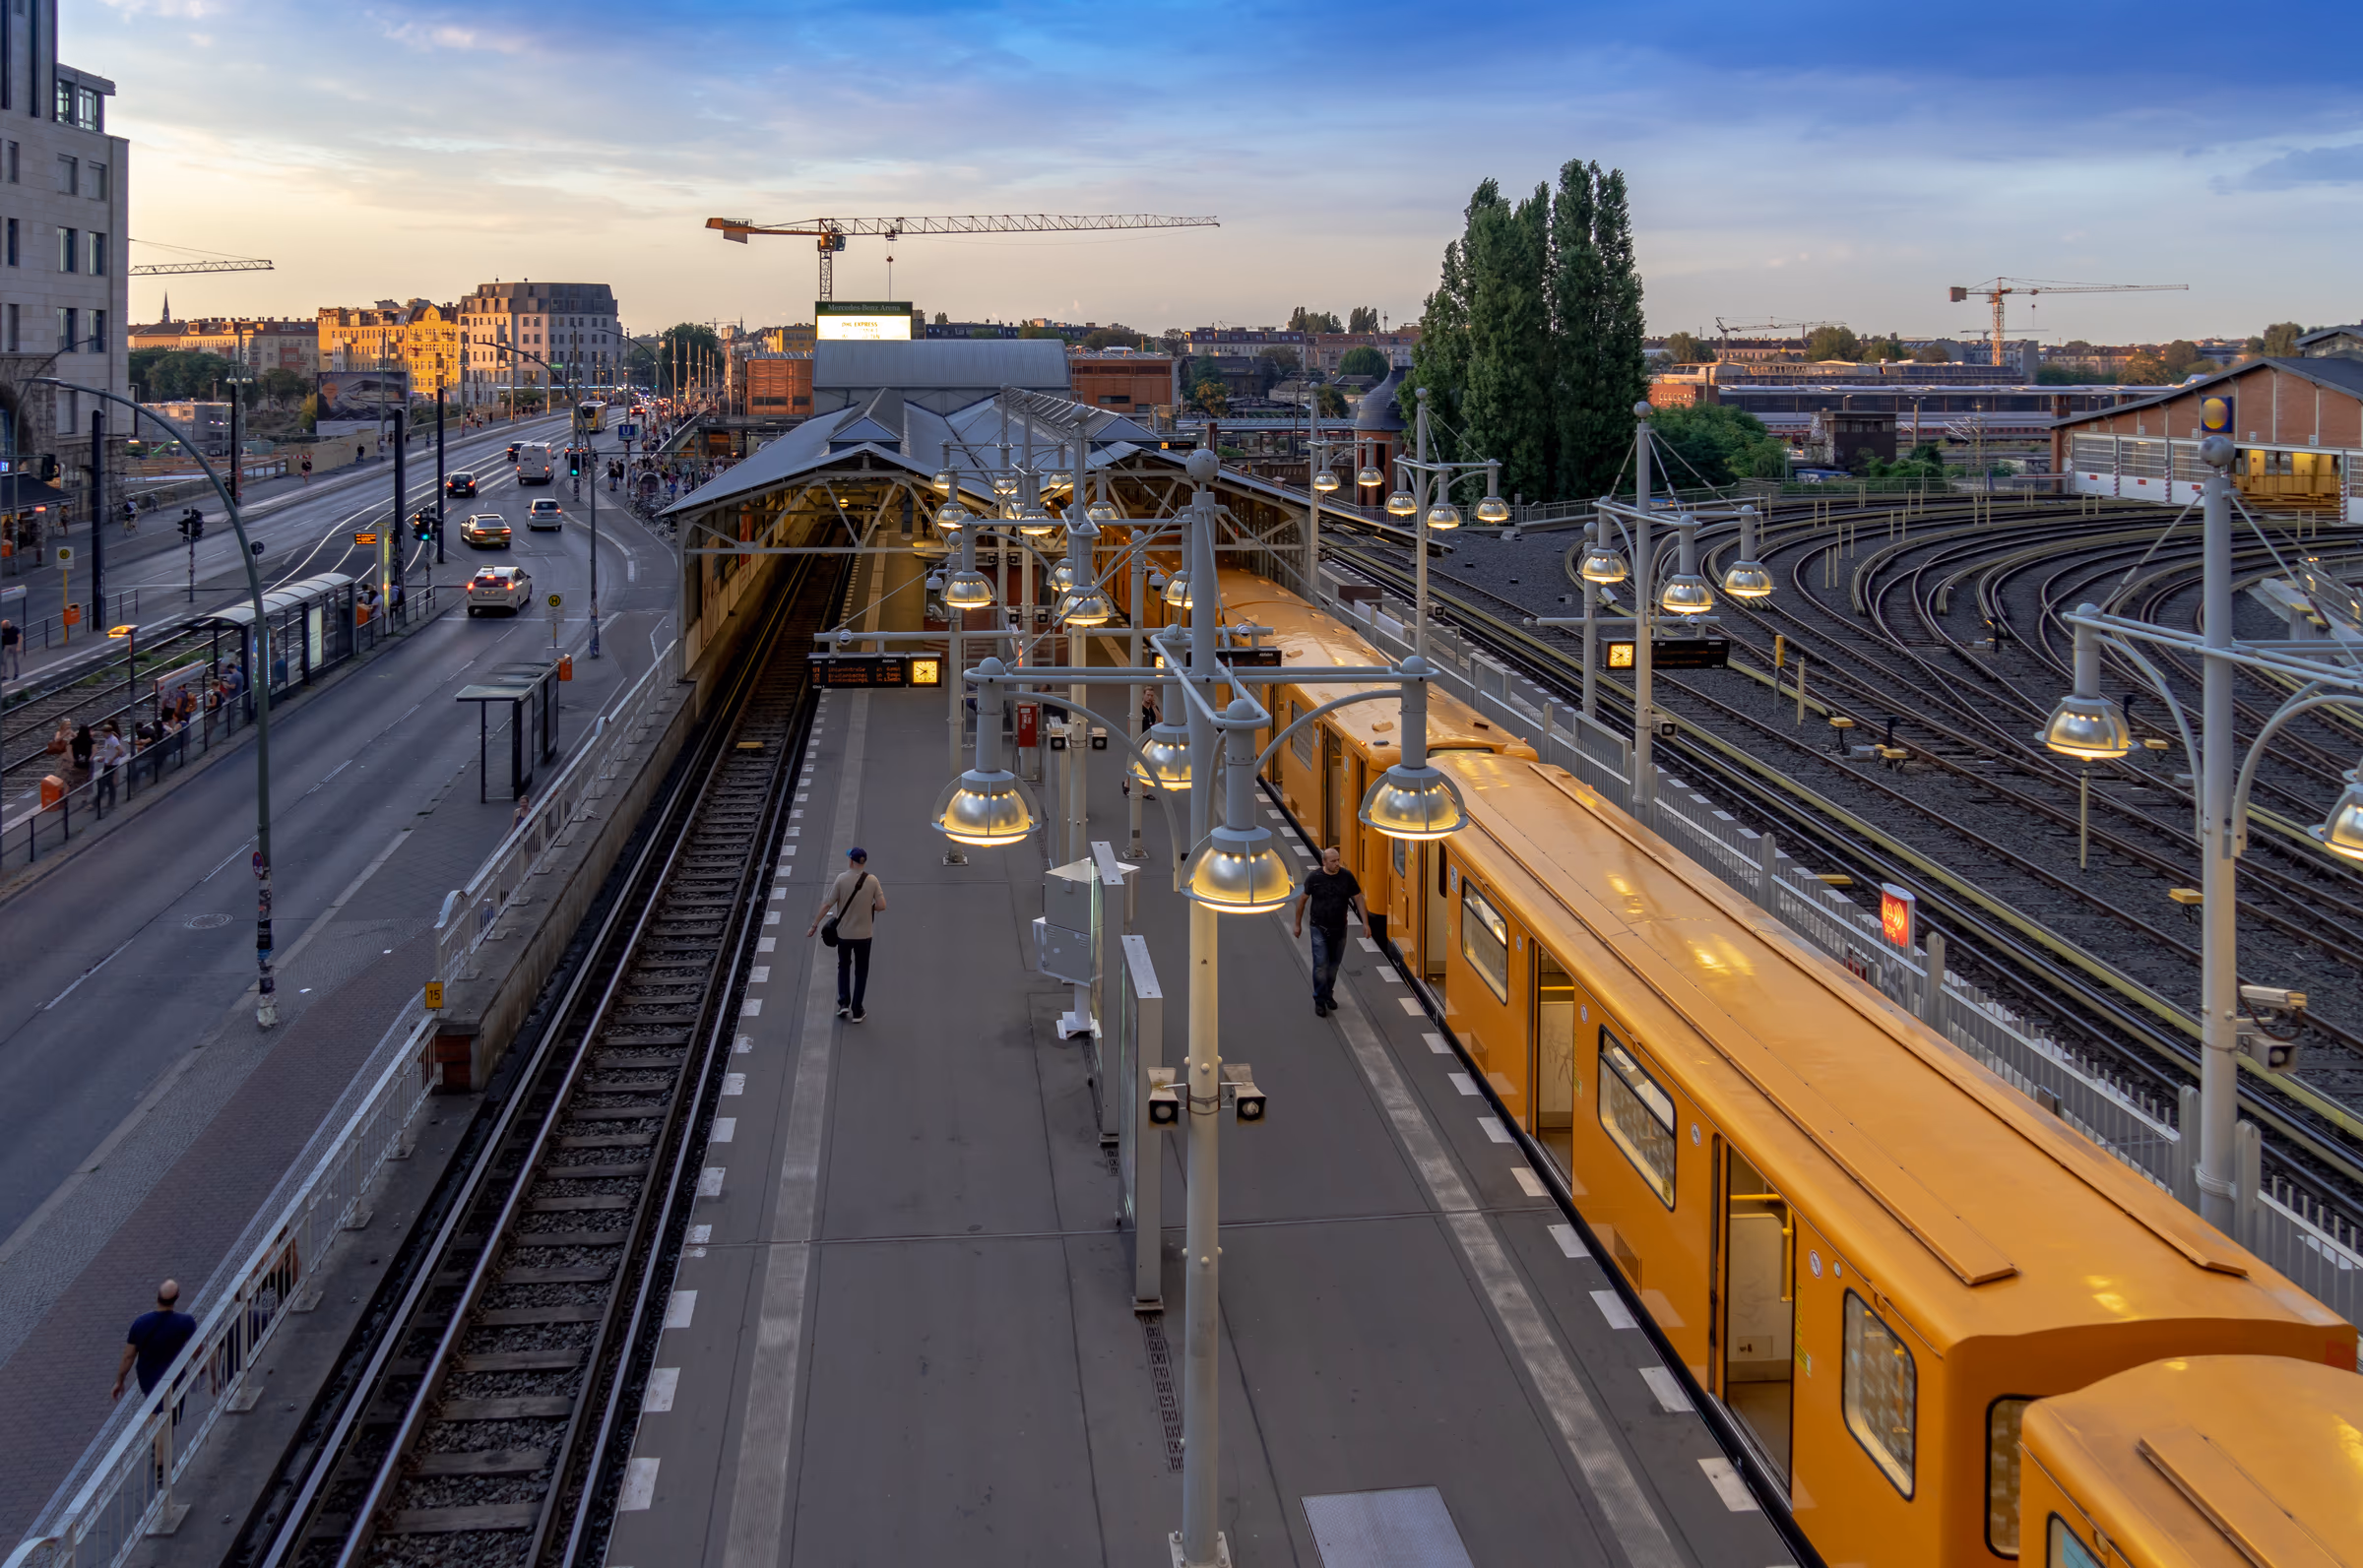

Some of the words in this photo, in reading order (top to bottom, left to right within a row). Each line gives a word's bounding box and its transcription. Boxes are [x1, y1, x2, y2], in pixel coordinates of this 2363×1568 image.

[828, 303, 879, 312] Mercedes-Benz
[622, 425, 631, 435] U
[1884, 922, 1896, 938] SOS
[428, 989, 441, 1001] 15
